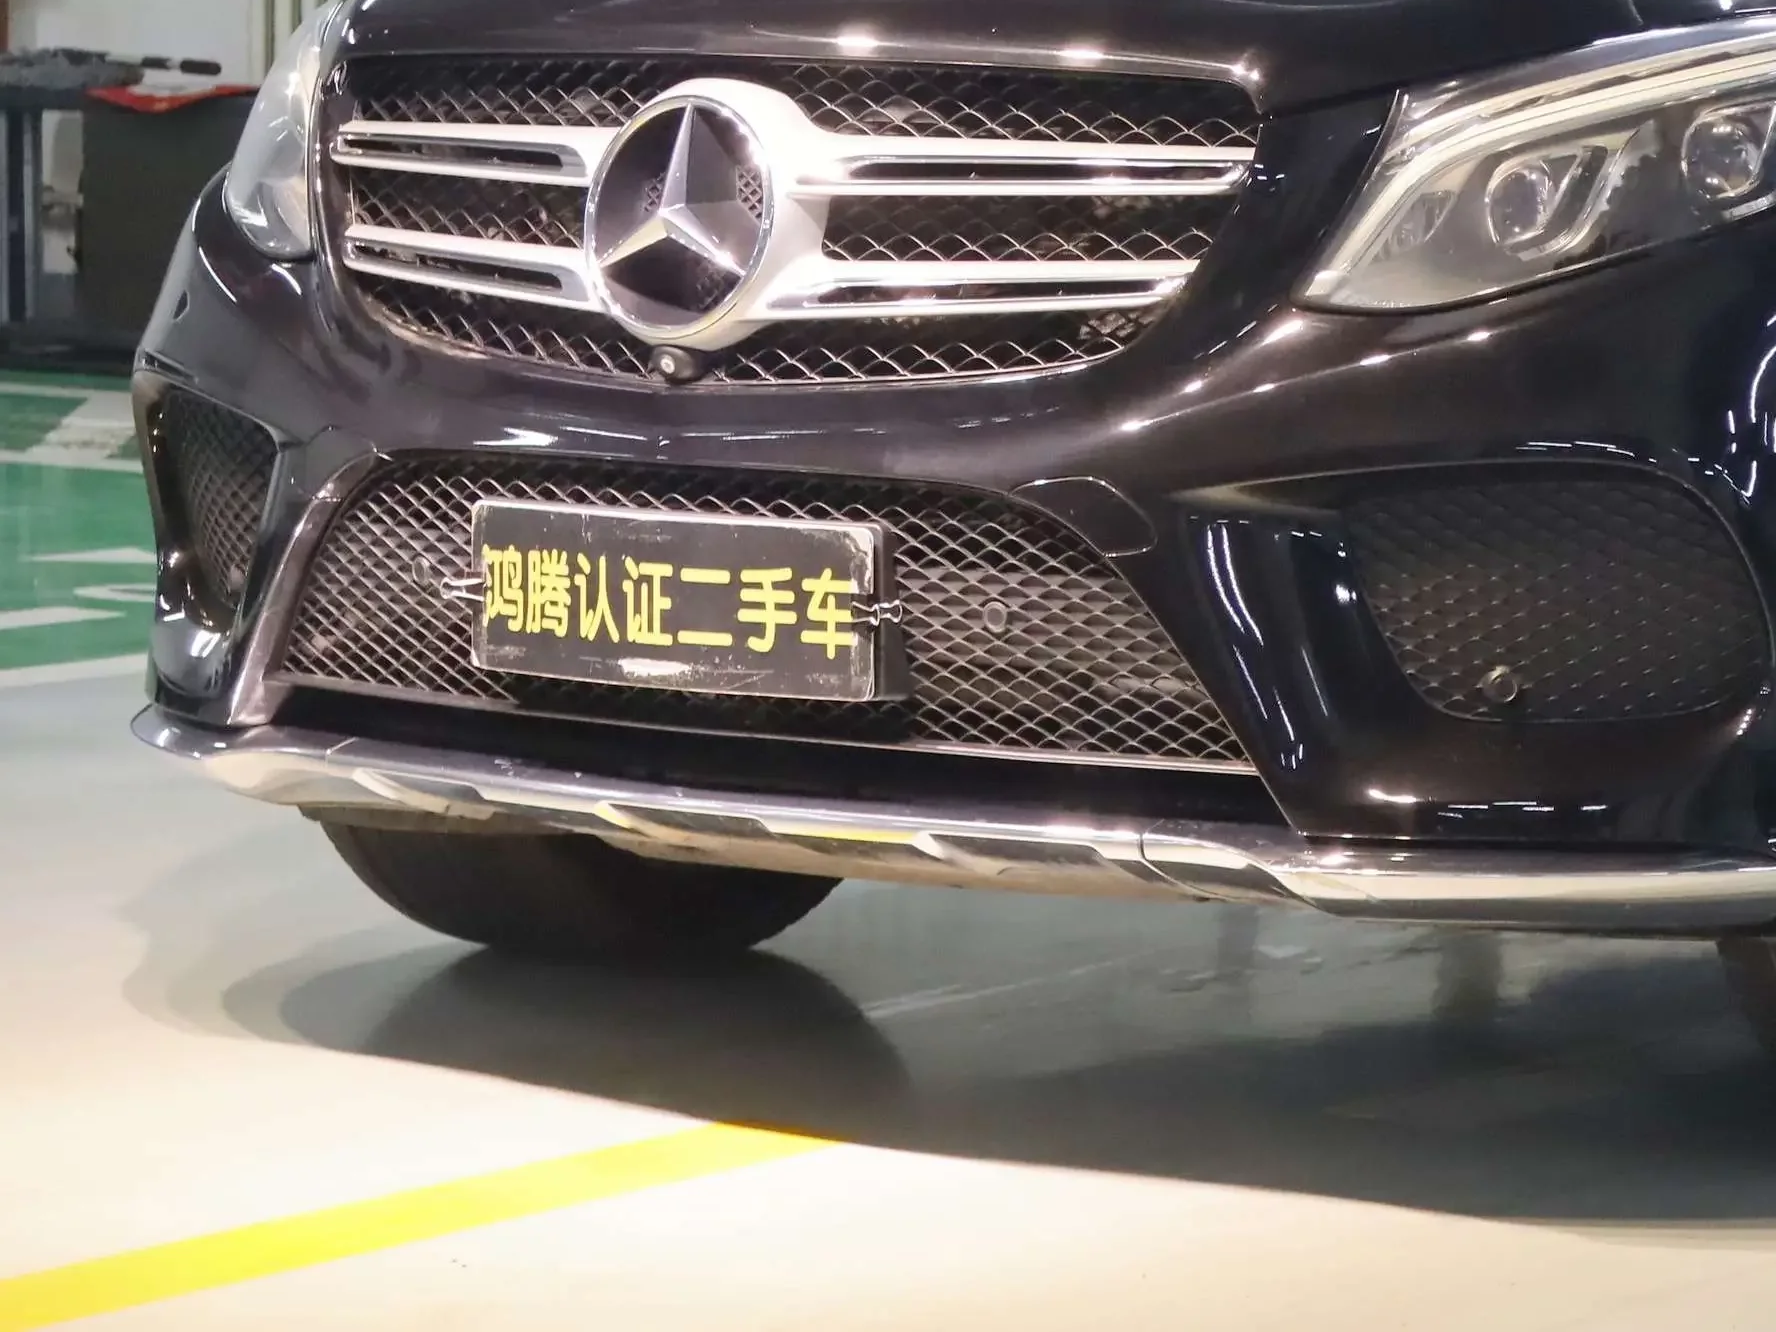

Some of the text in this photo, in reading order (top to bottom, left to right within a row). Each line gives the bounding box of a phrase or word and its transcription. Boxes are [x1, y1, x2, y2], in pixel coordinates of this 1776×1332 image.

[481, 544, 857, 659] 鸿腾认证二手车
